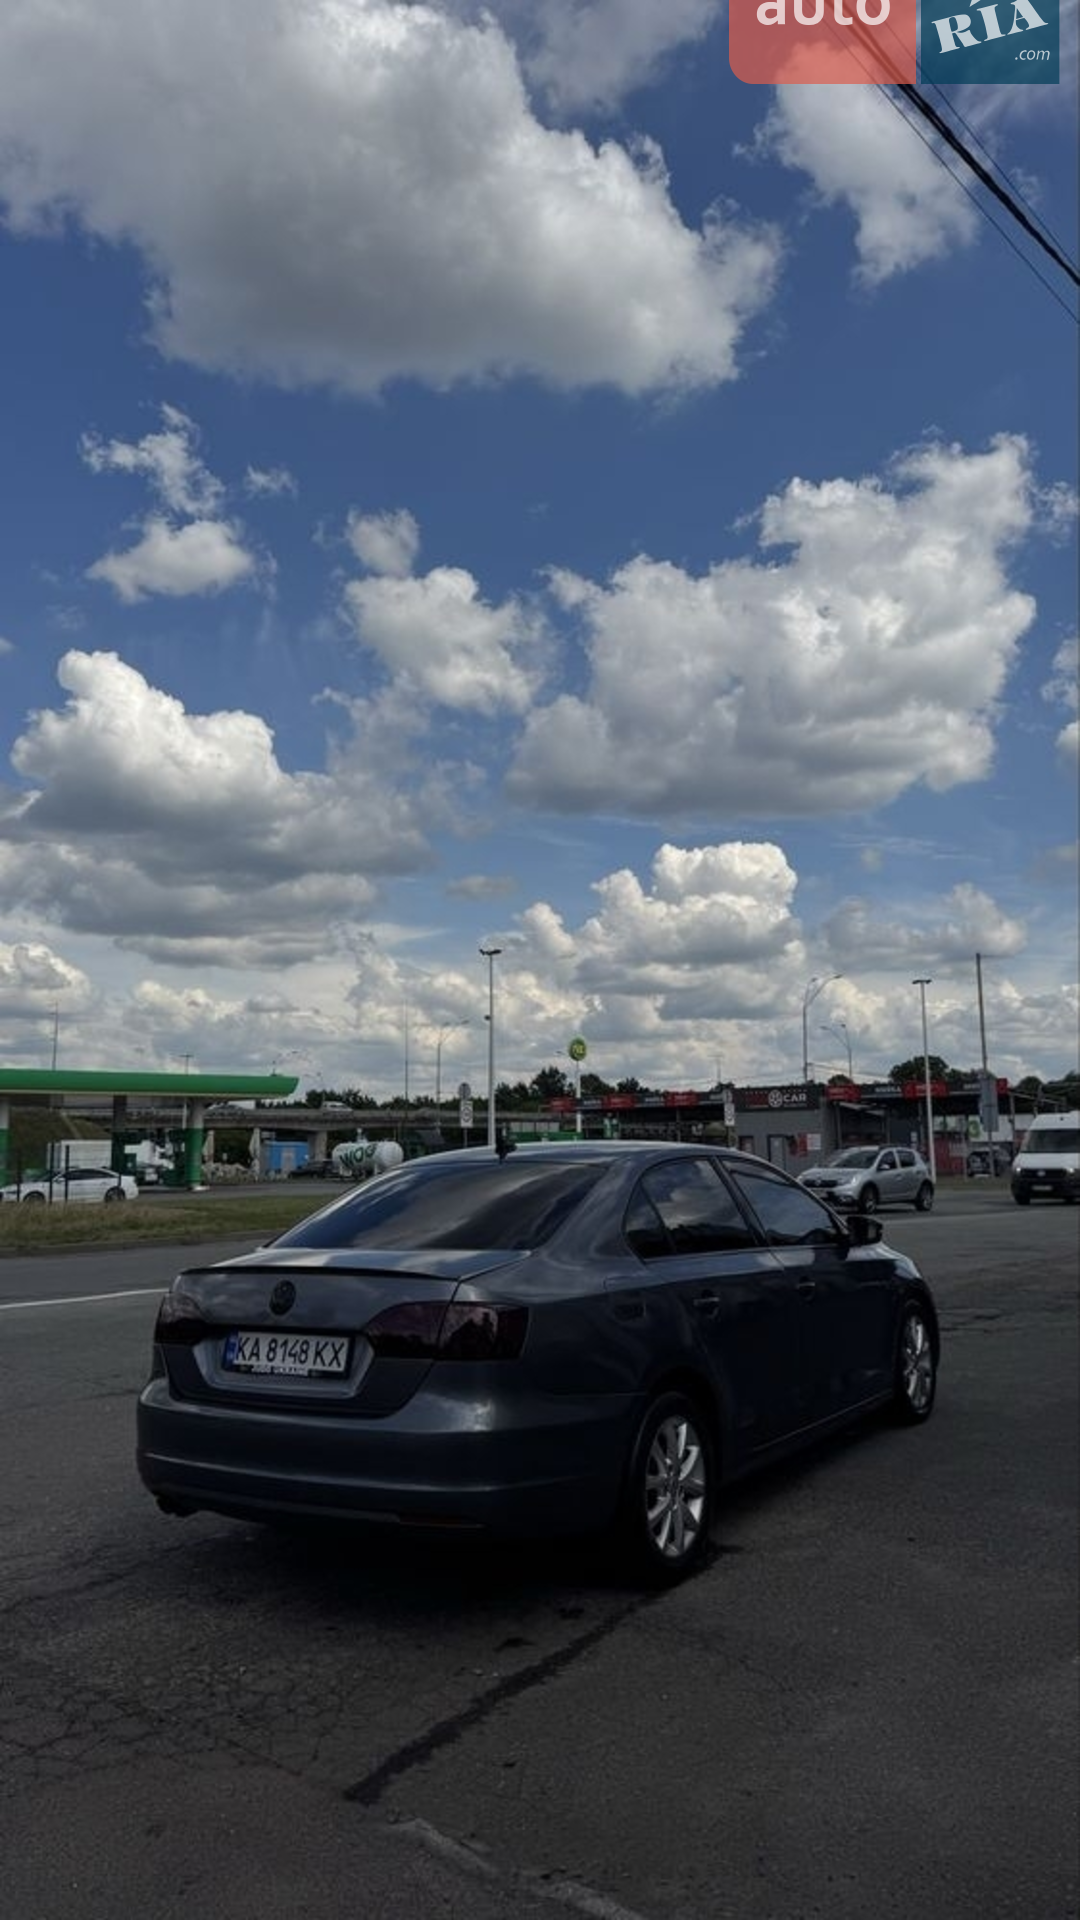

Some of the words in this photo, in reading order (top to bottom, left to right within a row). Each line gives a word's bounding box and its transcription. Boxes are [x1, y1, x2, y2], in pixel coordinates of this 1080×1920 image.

[783, 1093, 807, 1102] CAR
[338, 1143, 377, 1168] WOG
[235, 1336, 261, 1362] KA
[266, 1338, 310, 1364] 8148
[313, 1341, 345, 1368] KX
